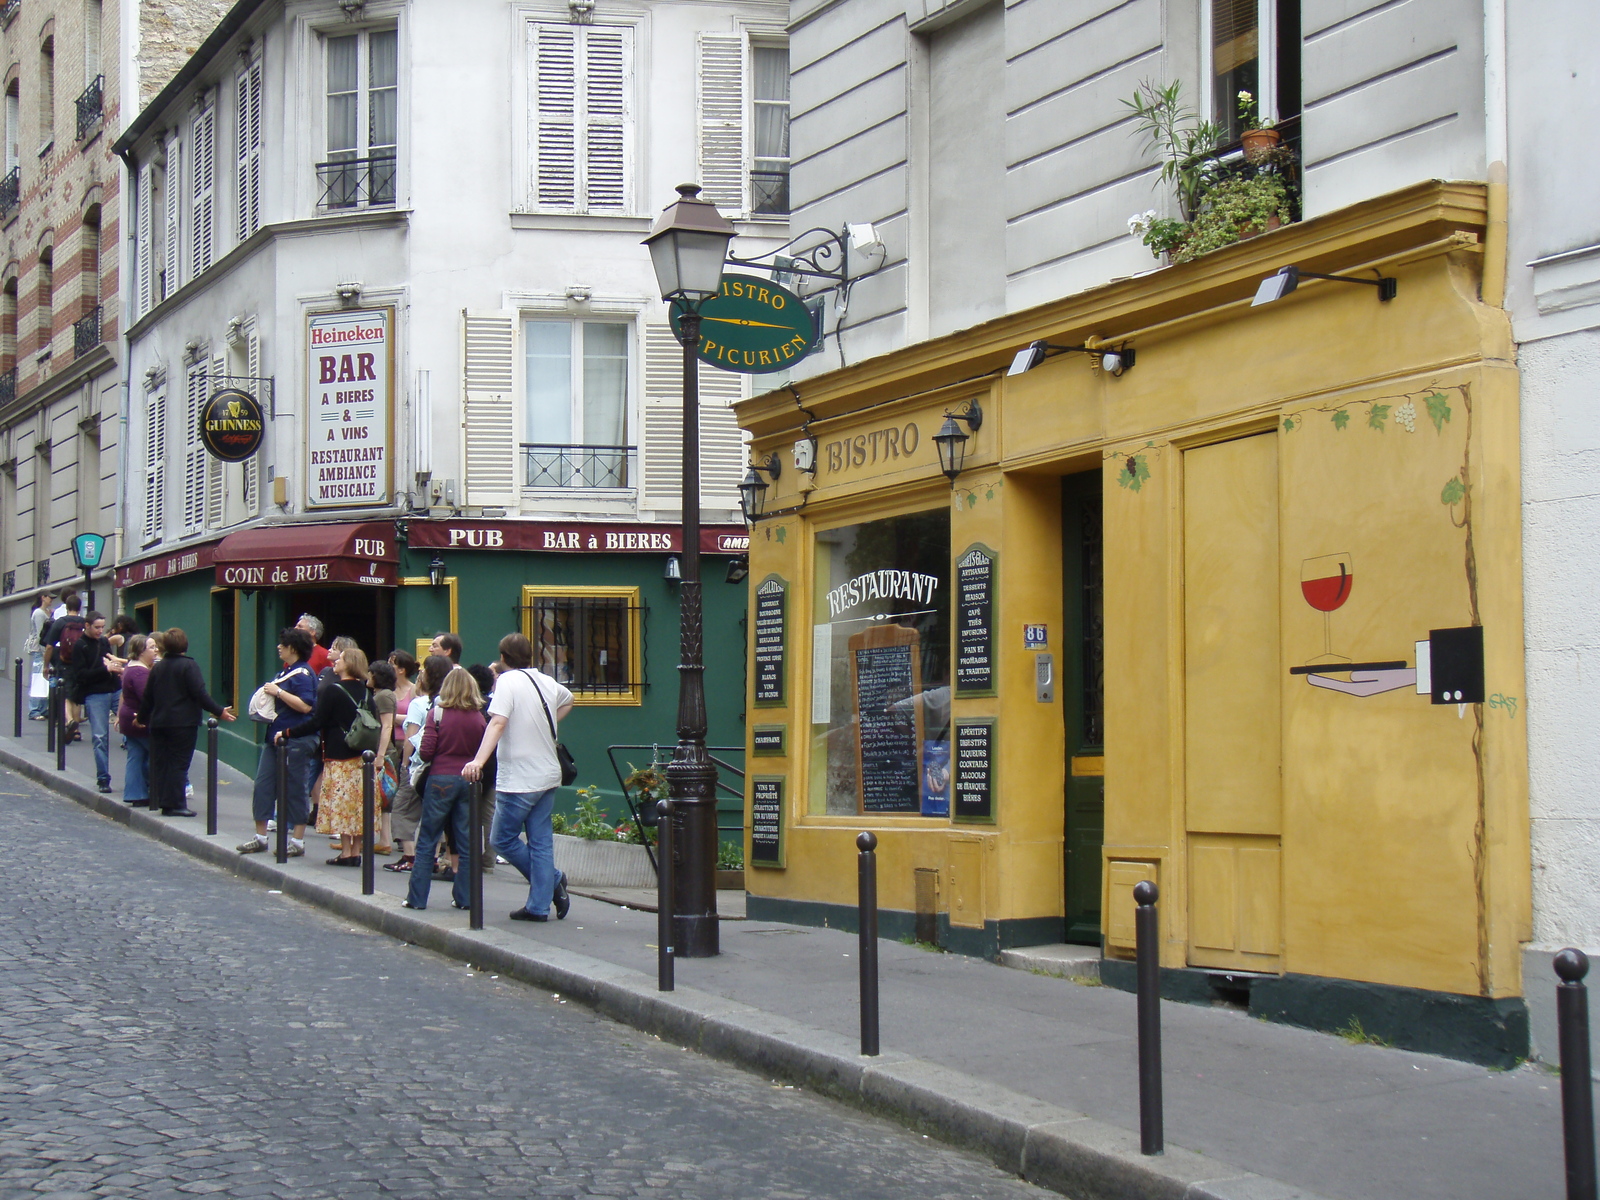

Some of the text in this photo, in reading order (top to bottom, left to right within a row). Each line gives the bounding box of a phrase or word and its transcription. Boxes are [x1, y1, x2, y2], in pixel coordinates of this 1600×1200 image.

[711, 282, 786, 310] ISTRO
[311, 325, 385, 345] Heineken
[698, 333, 807, 366] PICURIEN
[319, 352, 377, 385] BAR
[321, 388, 375, 406] A BIERES
[342, 409, 352, 422] &
[205, 419, 262, 431] GUINNESS
[327, 426, 369, 442] A VINS
[311, 446, 384, 465] RESTAURANT
[825, 421, 919, 475] BISTRO
[318, 464, 377, 482] AMBIANCE
[319, 482, 375, 499] MUSICALE
[449, 529, 504, 547] PUB
[543, 531, 672, 550] BAR à BIERES
[355, 538, 385, 557] PUB
[144, 563, 157, 579] PUB
[224, 563, 329, 584] COIN de RUE
[359, 576, 385, 584] GUINNESS
[963, 583, 986, 591] DESSERTS
[826, 569, 938, 618] RESTAURANT
[961, 627, 987, 636] INFUSIONS
[1027, 626, 1044, 641] 86
[964, 646, 976, 654] PAIN
[960, 656, 987, 664] FROMAGES
[966, 667, 990, 675] TRADITION
[960, 727, 987, 736] APÉRITIFS
[959, 738, 987, 747] DIGESTIFS
[960, 749, 987, 758] LIQUEURS
[959, 760, 988, 768] COCKTAILS
[960, 771, 986, 780] ALCOOLS
